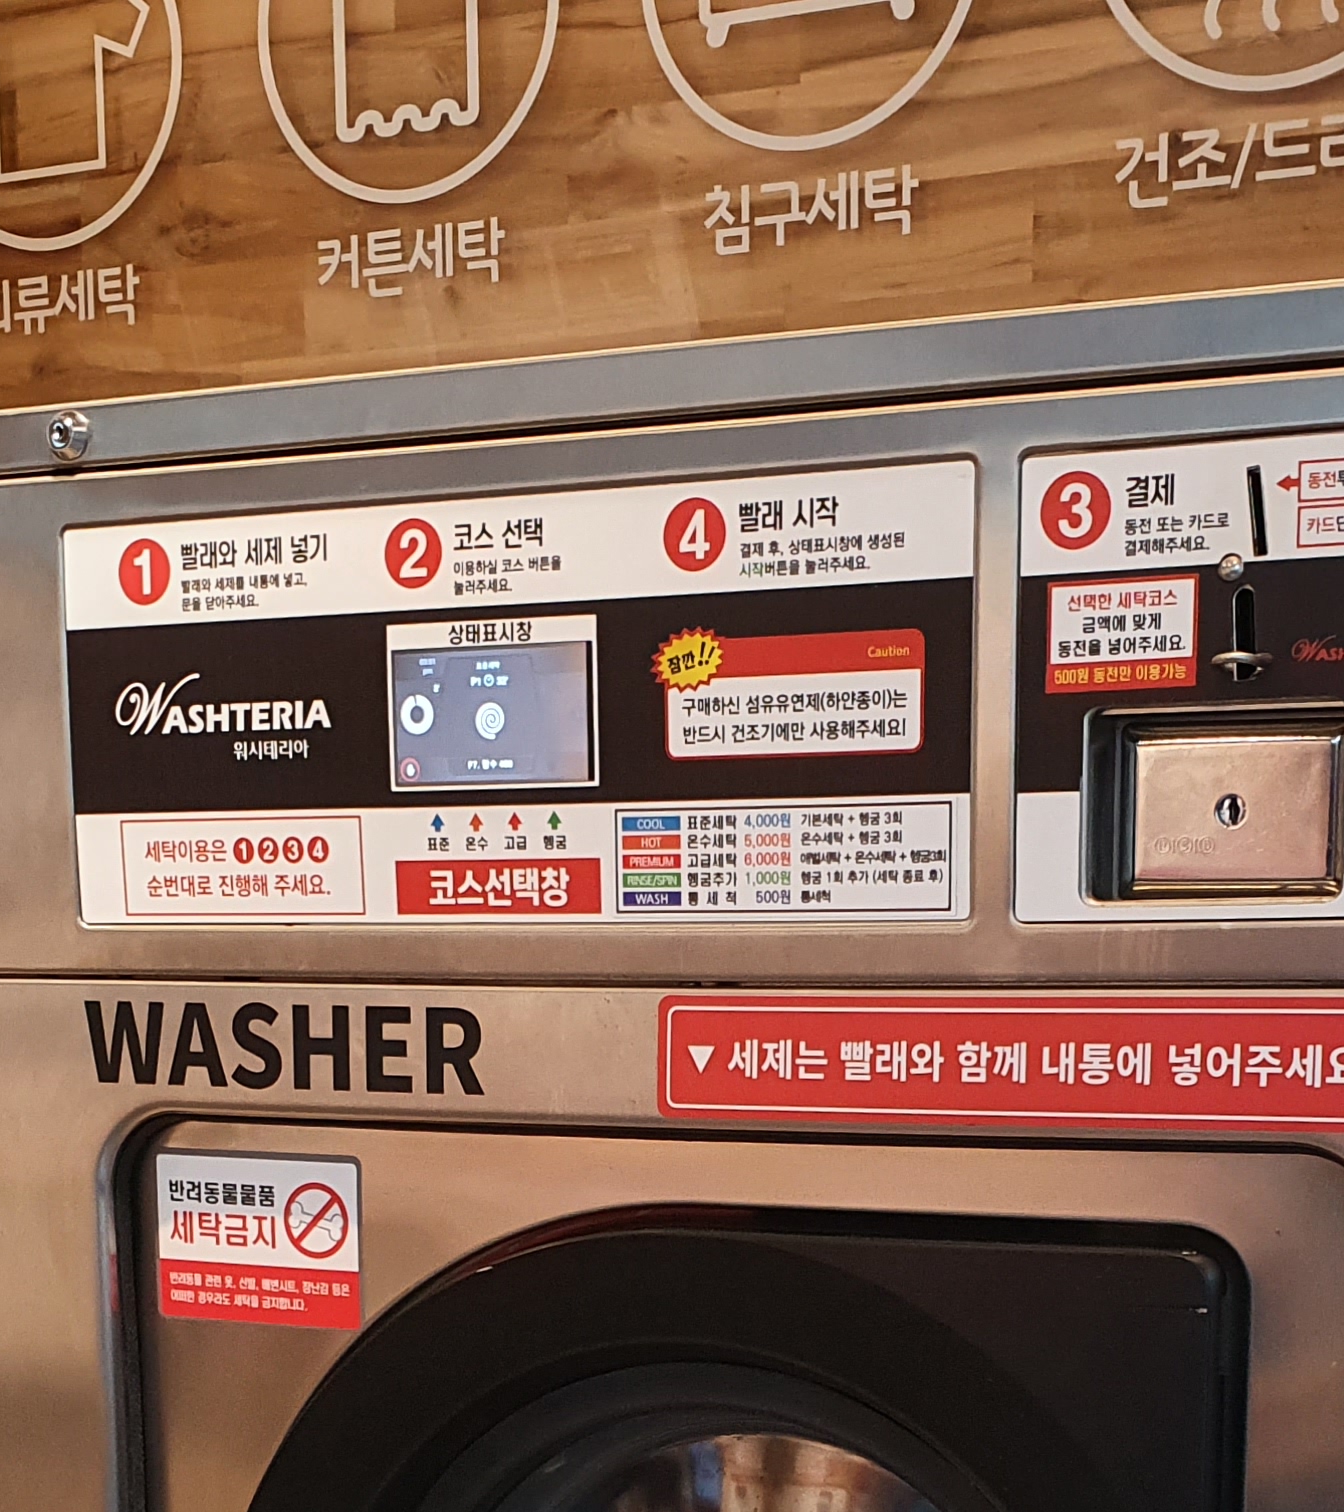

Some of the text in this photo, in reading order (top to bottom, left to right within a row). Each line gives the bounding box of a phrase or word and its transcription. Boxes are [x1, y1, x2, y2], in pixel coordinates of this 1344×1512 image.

[703, 165, 920, 255] 침구세탁
[317, 216, 505, 291] 커튼세탁
[1125, 473, 1175, 508] 결제
[739, 496, 838, 533] 빨래 시작
[1124, 513, 1230, 536] 동전 또는 카드로
[454, 518, 543, 551] 코스 선택
[740, 532, 905, 559] 결제 후, 상태표시창에 생성된
[1124, 536, 1210, 556] 결제해주세요.
[180, 533, 328, 571] 빨래와 세제 넣기
[454, 554, 561, 576] 이용하실 코스 버튼을
[740, 560, 799, 578] 시작버튼을
[1067, 590, 1178, 612] 선택한 세탁코스
[449, 621, 532, 645] 상태표시창
[1082, 612, 1162, 633] 금액에 맞게
[667, 641, 715, 675] 잠깐!!
[868, 645, 910, 658] Caution
[1058, 635, 1186, 658] 동전을 넣어주세요.
[1054, 663, 1187, 684] 500원 이용가능
[115, 673, 331, 736] WASHTERIA
[682, 689, 907, 716] 구매하신 섬유유연제(하얀종이)는
[683, 721, 805, 744] 반드시 건조기에만
[234, 739, 310, 761] 워시테리아
[637, 813, 791, 830] COOL 표준세탁 4,000원
[145, 839, 227, 864] 세탁이용은
[427, 835, 527, 852] 표준 온수 고급
[641, 833, 791, 848] HOT 온수세탁 5,000원
[630, 852, 791, 868] PREMIUM 고급세탁 6,000원
[147, 872, 332, 897] 순번대로 진행해 주세요.
[428, 868, 570, 908] 코스선택창
[746, 871, 791, 886] 1,000원
[635, 890, 791, 905] WASH 500원
[87, 999, 485, 1098] WASHER
[728, 1040, 828, 1081] 세제는
[839, 1040, 944, 1085] 빨래와
[958, 1040, 1028, 1085] 함께
[1040, 1041, 1153, 1088] 내통에
[169, 1179, 275, 1207] 반려동물물품
[171, 1210, 276, 1249] 세탁금지
